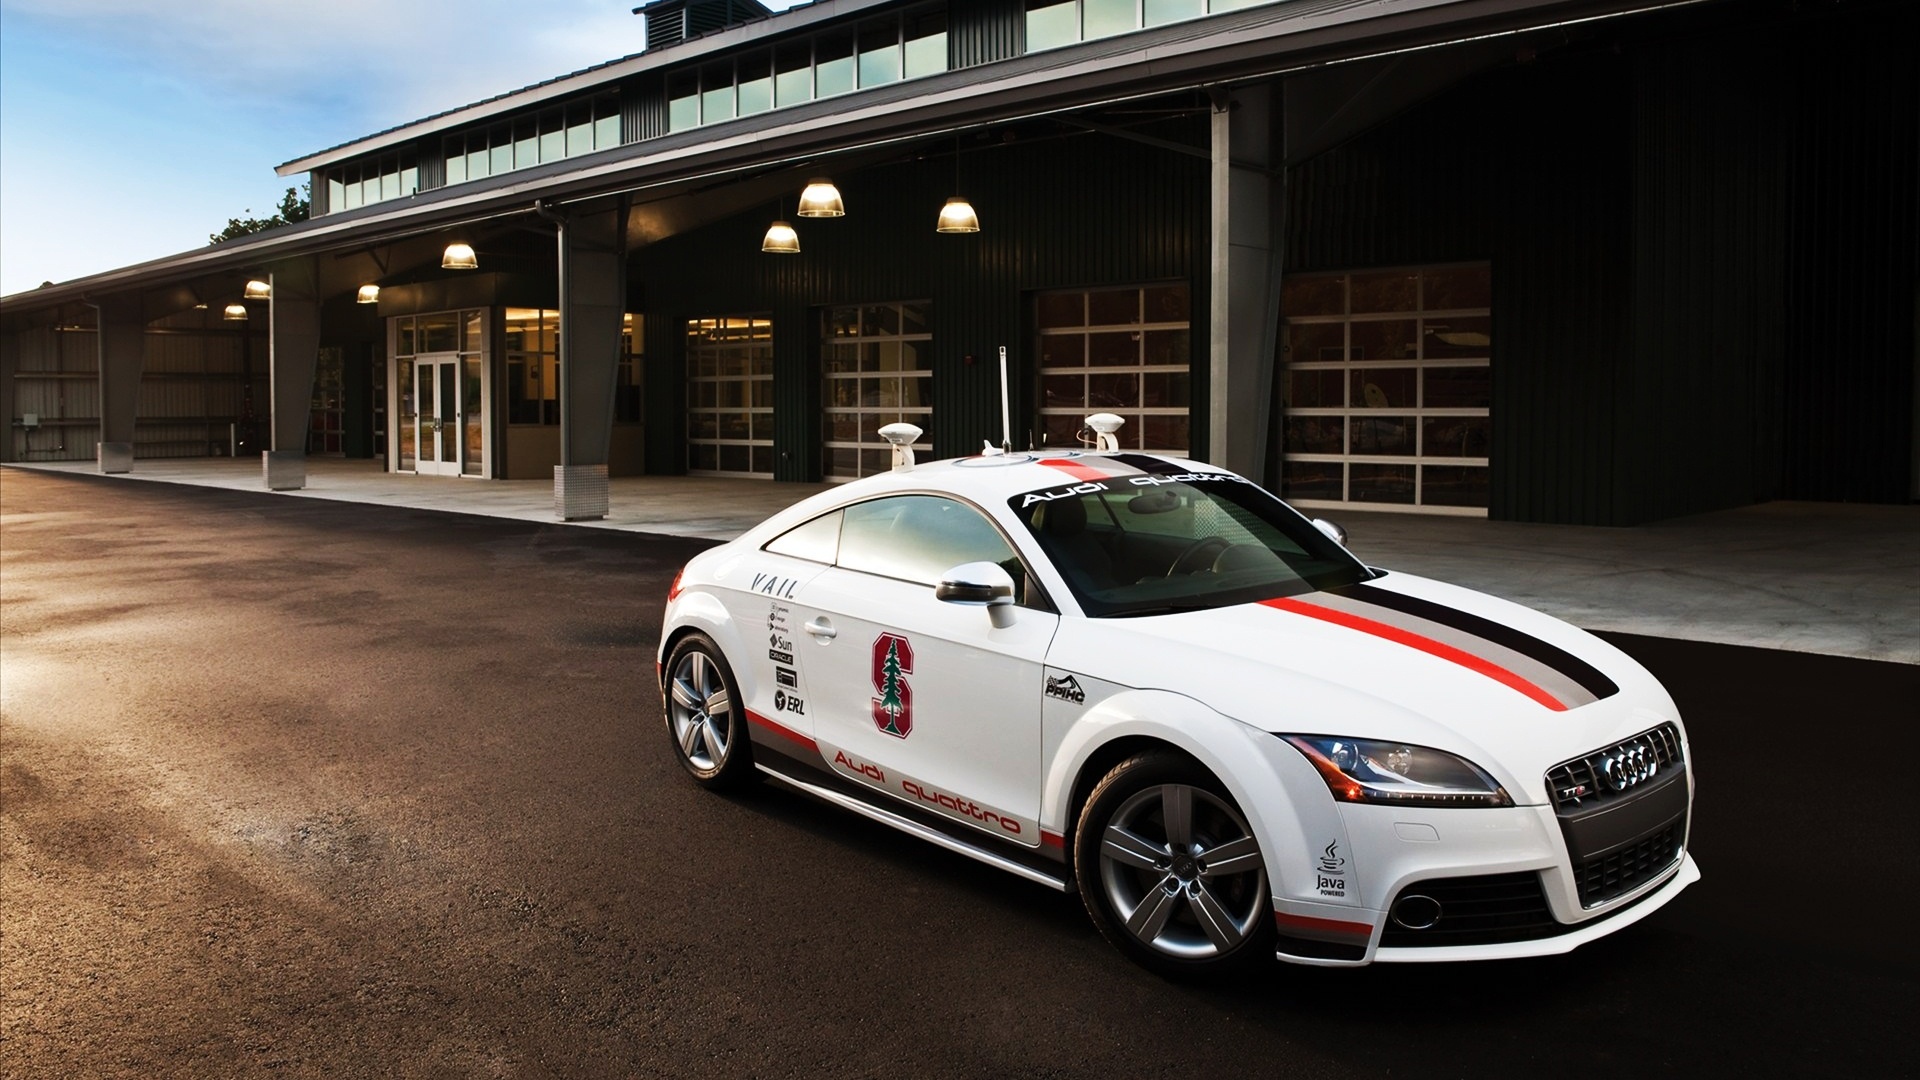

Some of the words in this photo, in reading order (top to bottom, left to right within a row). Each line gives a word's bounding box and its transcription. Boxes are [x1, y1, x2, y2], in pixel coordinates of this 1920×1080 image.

[1021, 482, 1109, 508] Audi
[751, 573, 798, 599] VAIL
[777, 636, 793, 652] Sun
[770, 651, 792, 663] ORACLE
[1045, 685, 1085, 702] PPIHC
[787, 695, 805, 716] ERL
[834, 750, 885, 783] Audi
[902, 780, 1021, 834] quattro
[1316, 874, 1345, 890] Java
